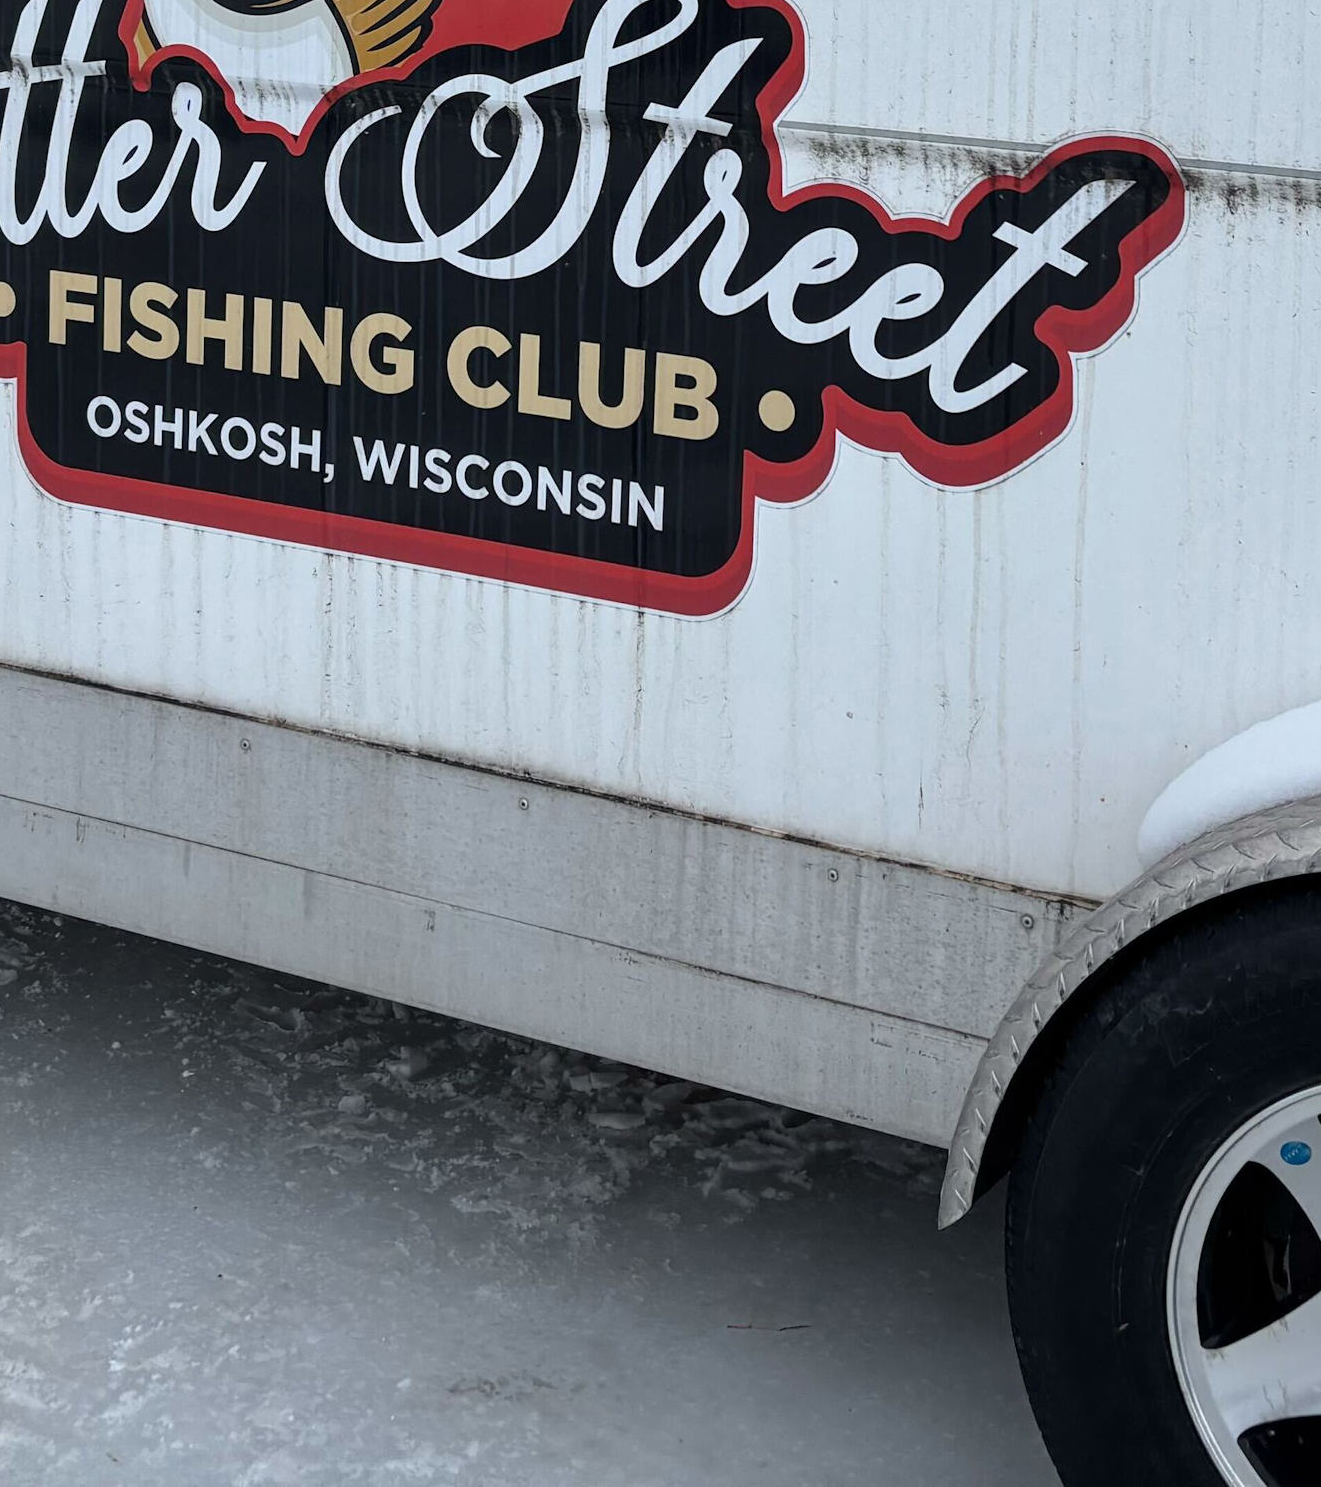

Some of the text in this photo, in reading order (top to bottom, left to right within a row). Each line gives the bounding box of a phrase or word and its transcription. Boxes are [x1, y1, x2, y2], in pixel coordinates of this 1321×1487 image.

[48, 269, 720, 441] FISHING CLUB
[86, 395, 666, 532] OSHKOSH, WISCONSIN
